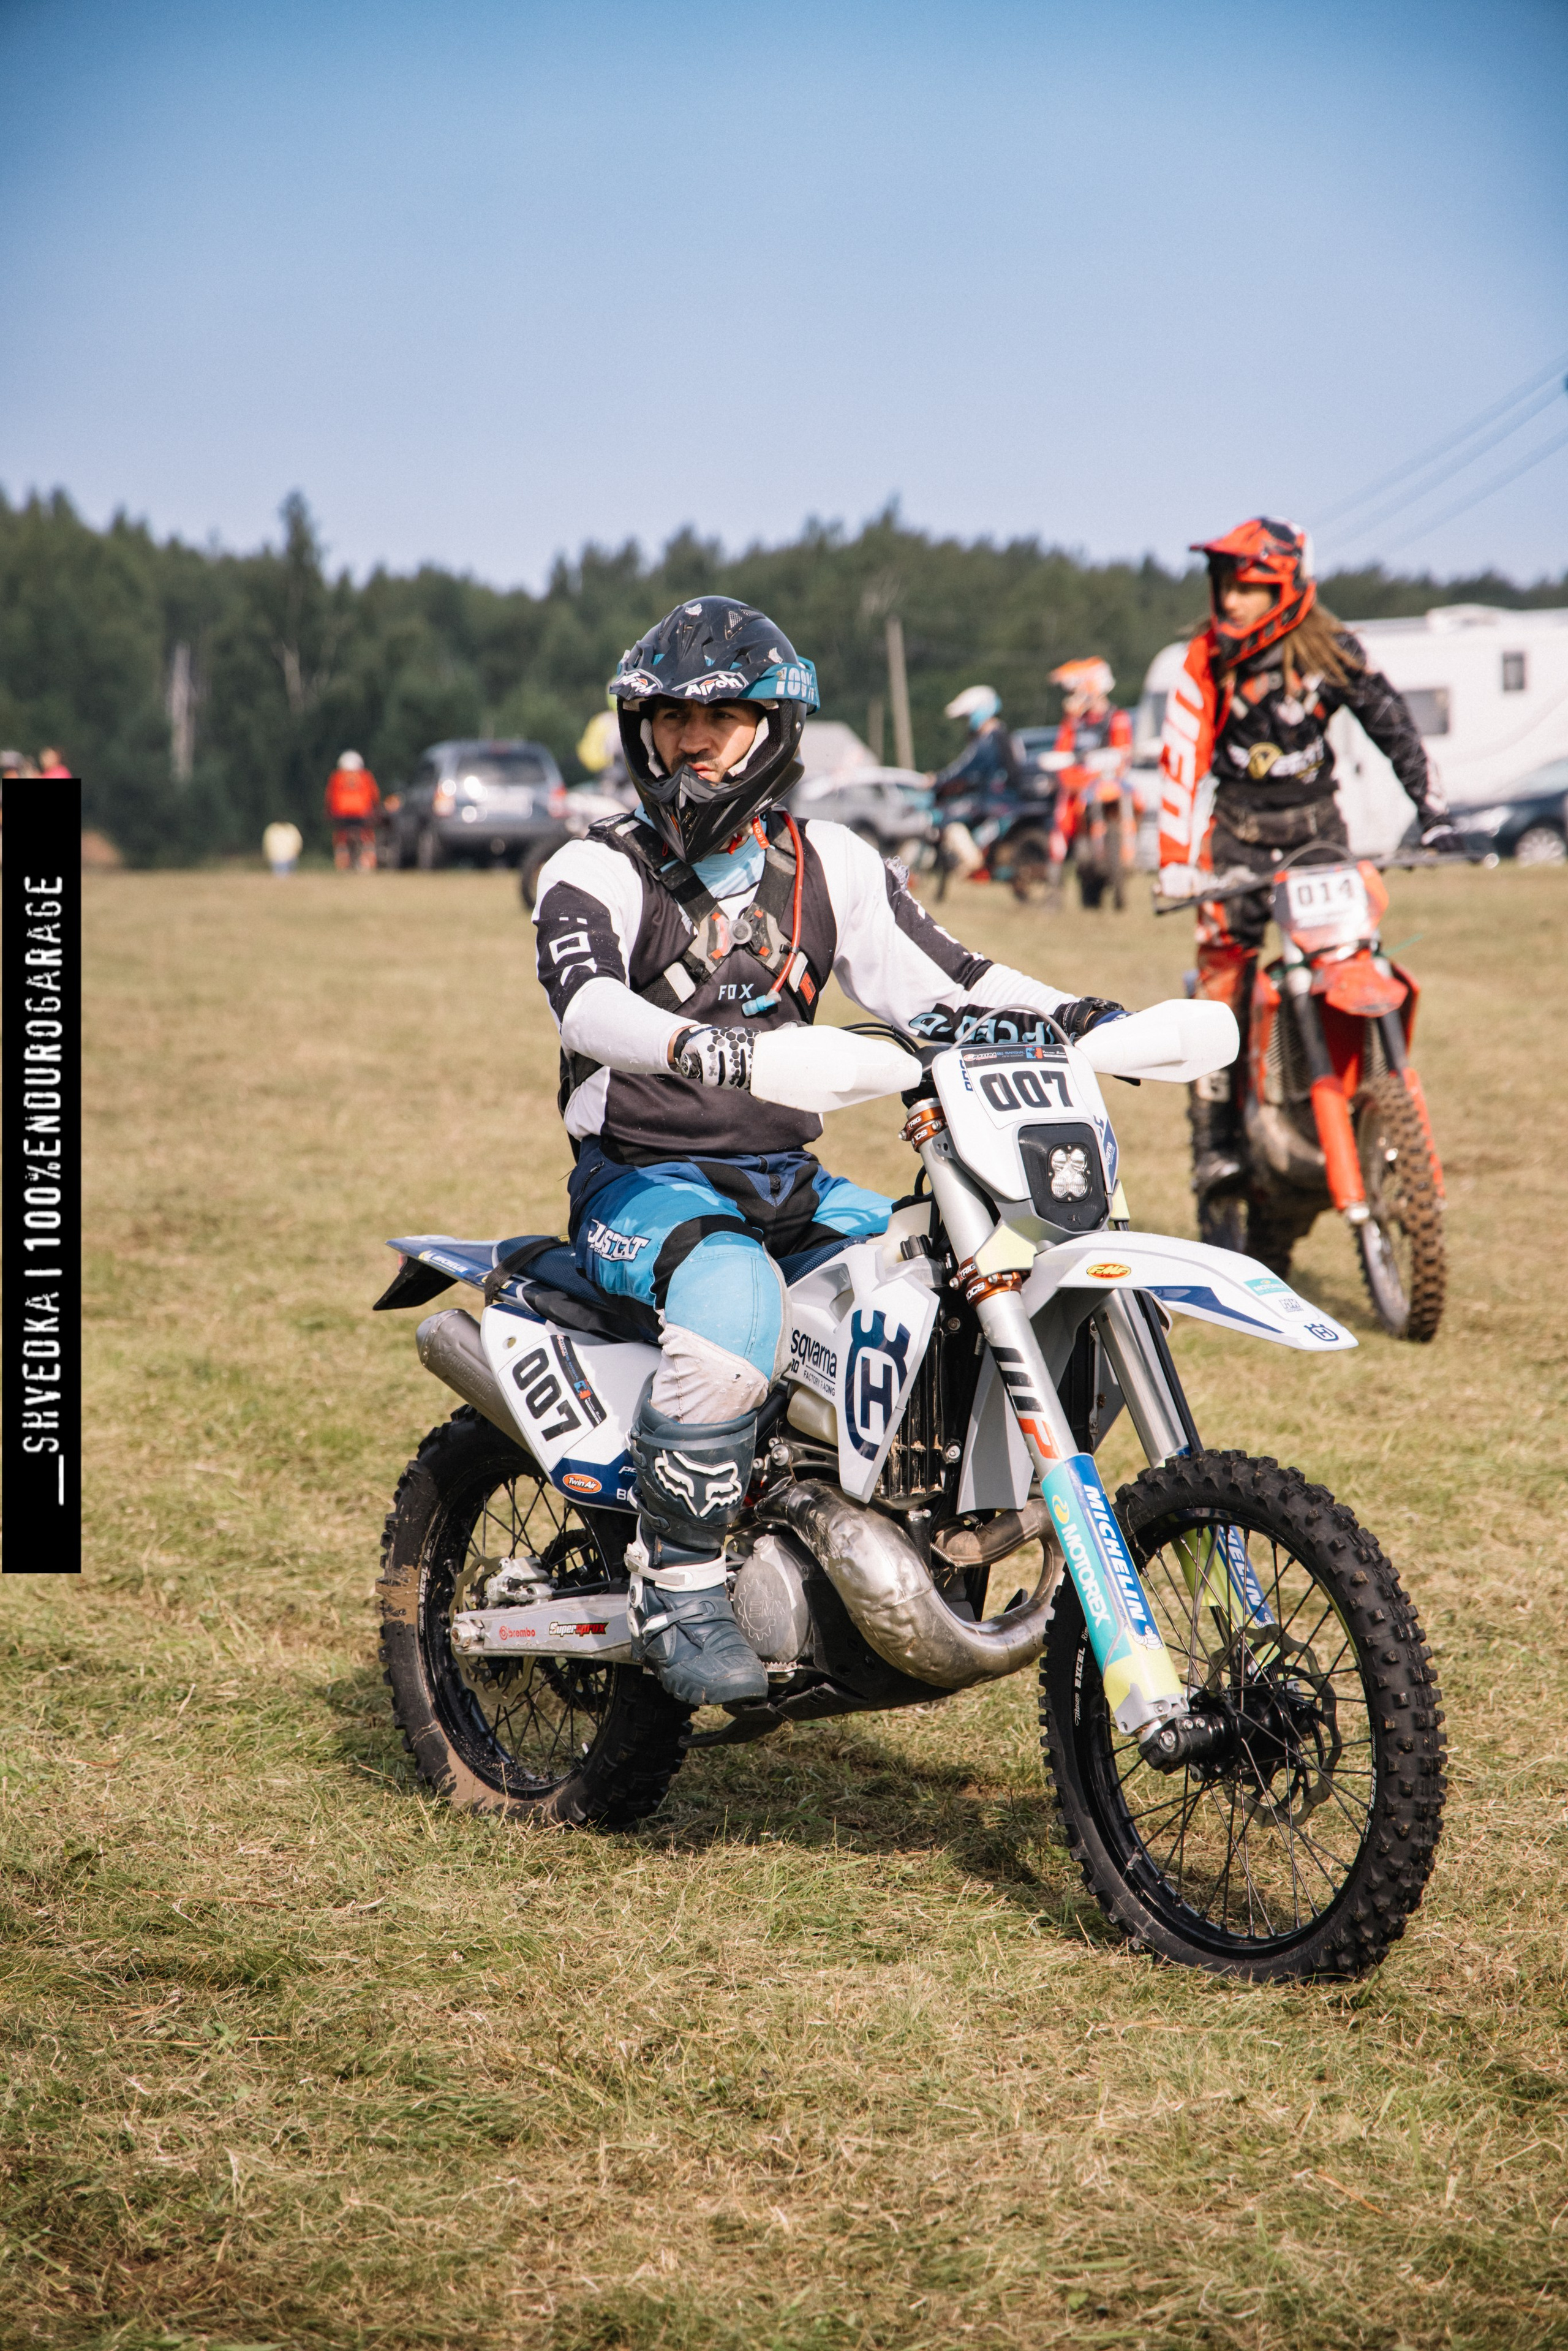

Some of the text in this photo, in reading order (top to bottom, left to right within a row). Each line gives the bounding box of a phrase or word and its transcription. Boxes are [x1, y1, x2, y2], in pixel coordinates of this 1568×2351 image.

[685, 674, 743, 696] Airoh
[754, 823, 766, 844] AIROH
[1298, 878, 1354, 905] 014
[718, 983, 754, 1000] FOX
[980, 1070, 1074, 1112] 007
[1087, 1265, 1130, 1275] FMF
[512, 1348, 581, 1442] 007
[804, 1370, 835, 1396] FACTORY RACING
[568, 1477, 584, 1487] Twin
[1084, 1484, 1147, 1622] MICHELIN
[1061, 1524, 1110, 1628] MOTOREX
[508, 1626, 536, 1637] brembo
[1074, 1647, 1085, 1689] EXCEL
